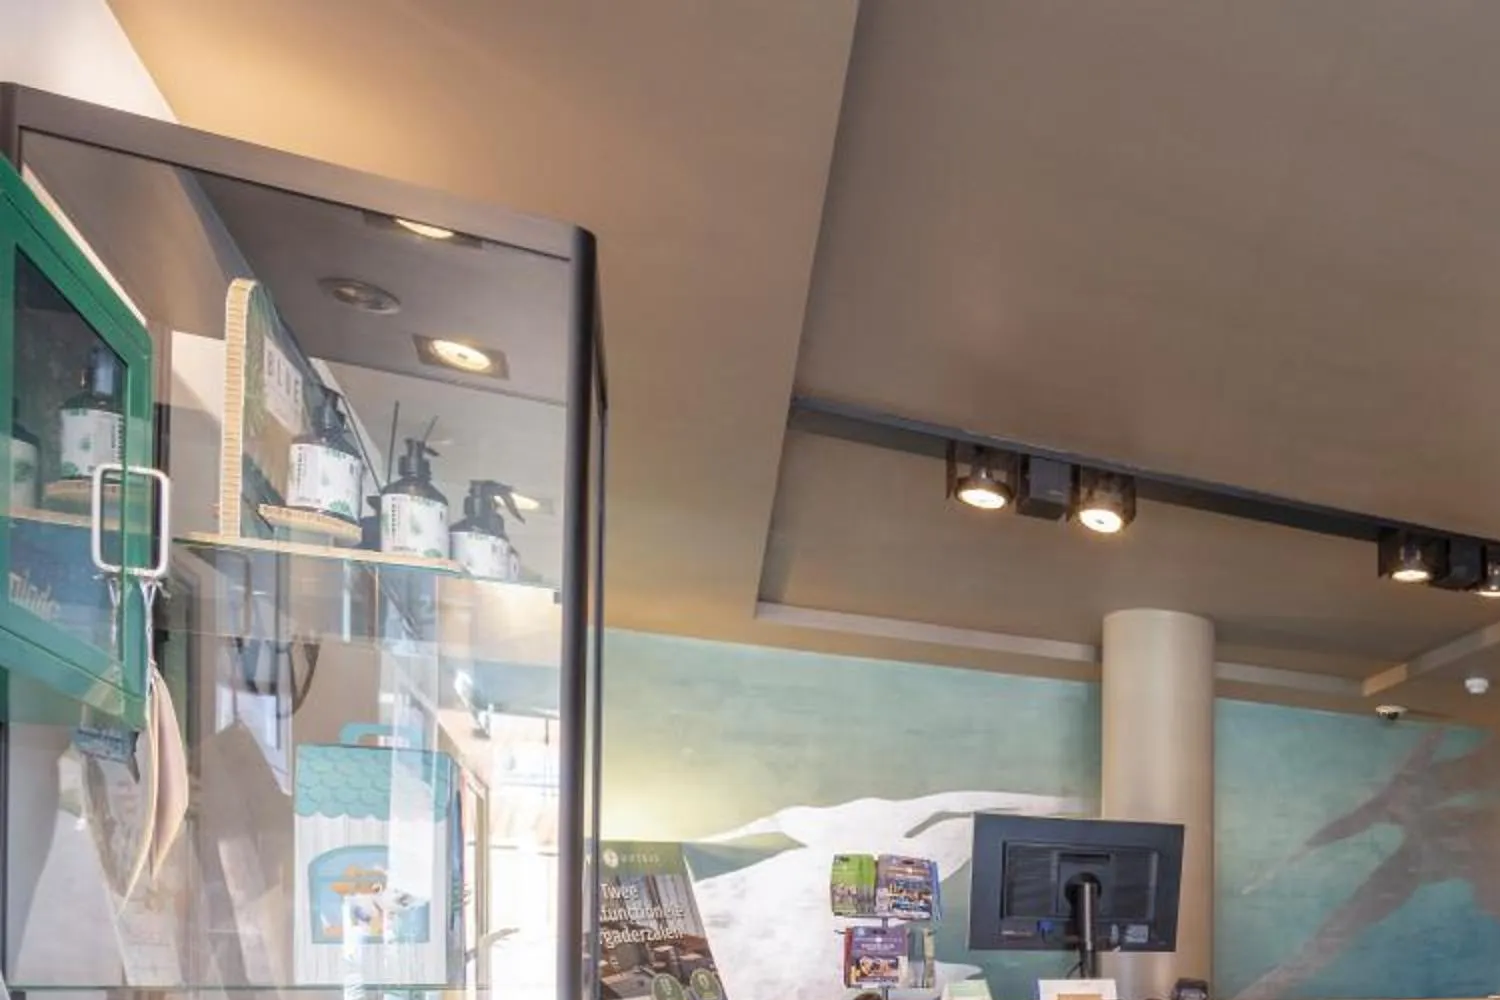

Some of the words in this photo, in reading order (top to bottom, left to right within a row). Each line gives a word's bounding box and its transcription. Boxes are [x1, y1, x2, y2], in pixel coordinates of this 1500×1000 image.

[266, 349, 300, 404] BLUE
[600, 882, 640, 900] Twee
[600, 922, 685, 949] rgaderzalen
